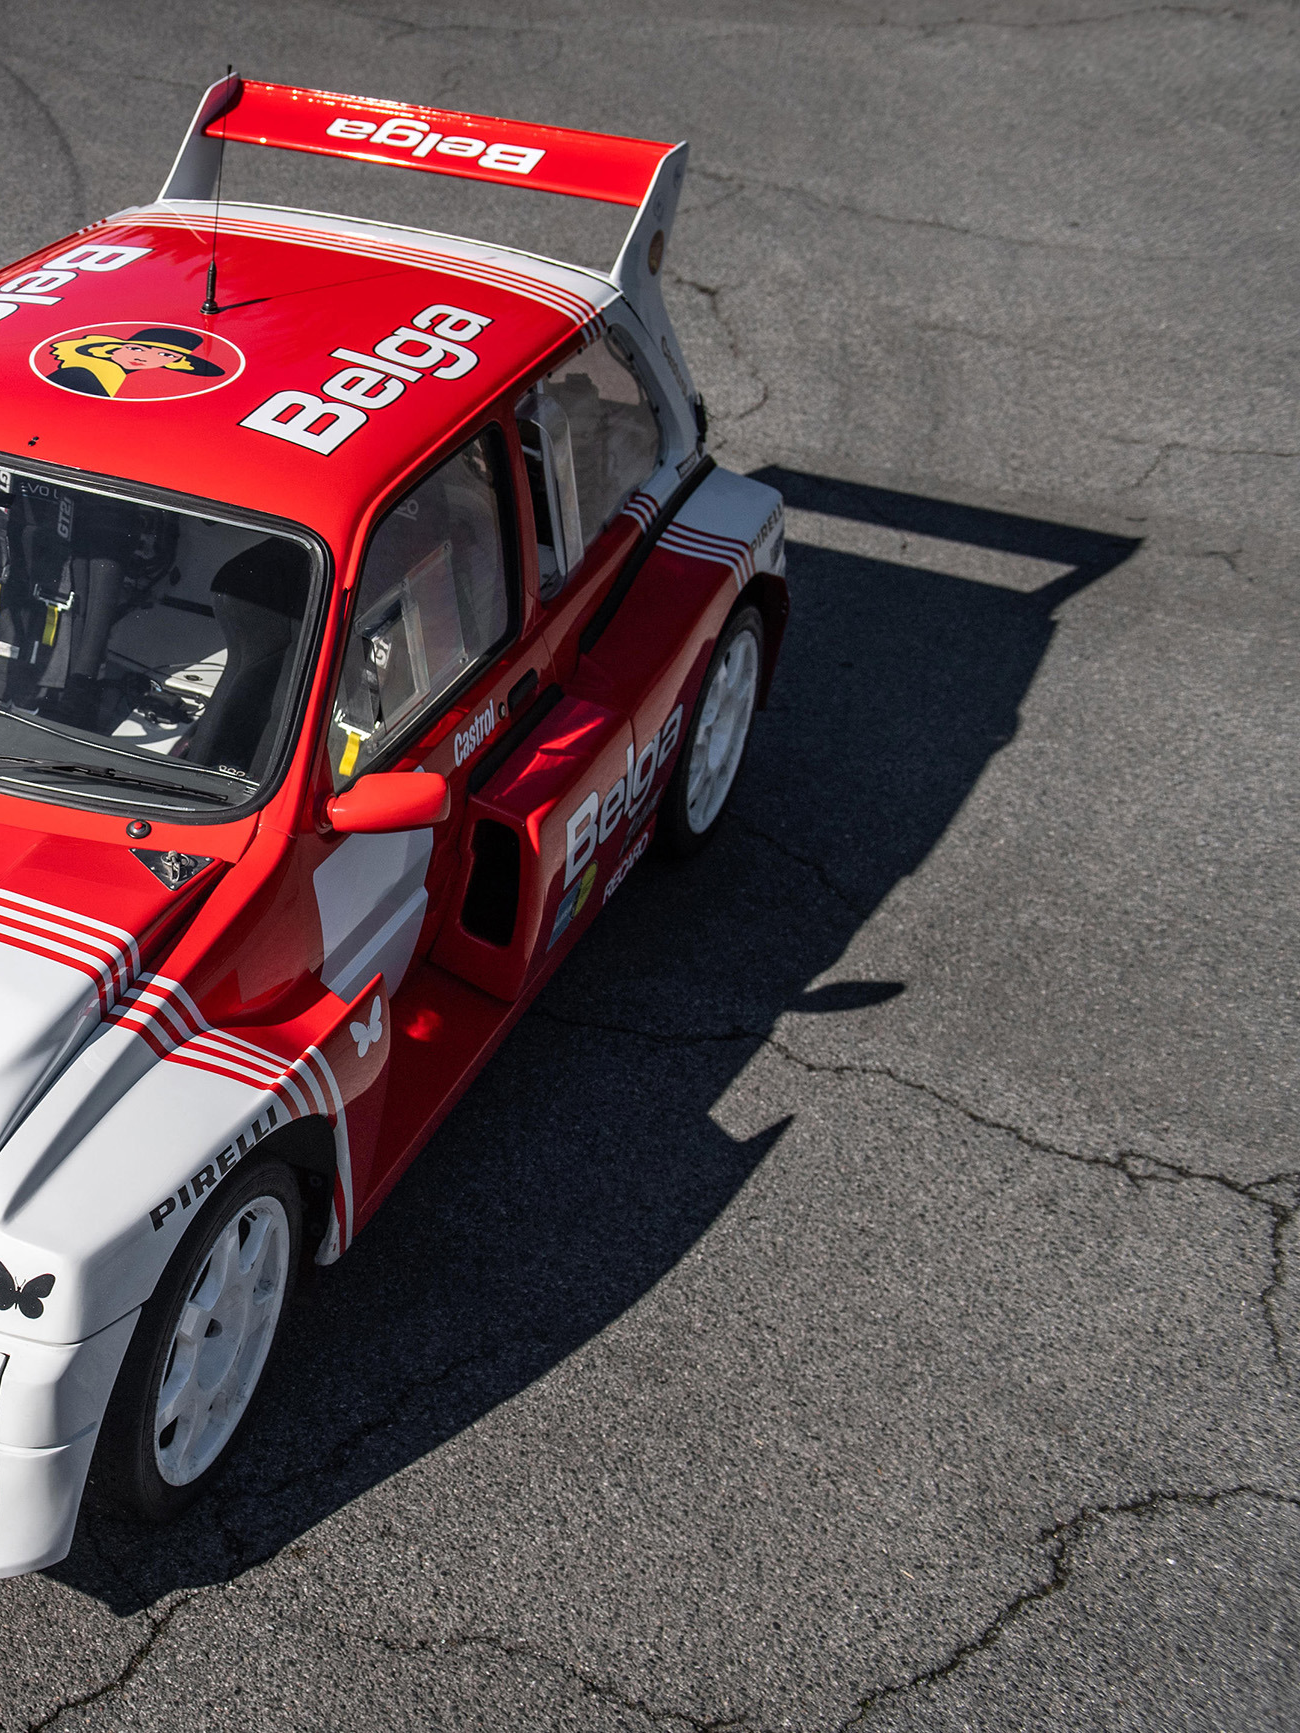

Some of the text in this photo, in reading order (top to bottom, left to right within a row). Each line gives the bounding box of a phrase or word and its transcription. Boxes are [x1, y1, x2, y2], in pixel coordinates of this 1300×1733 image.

[326, 116, 547, 175] Belga
[238, 304, 494, 456] Belga
[454, 698, 495, 767] Castrol
[563, 703, 683, 891] Belga
[149, 1105, 278, 1232] PIRELLI
